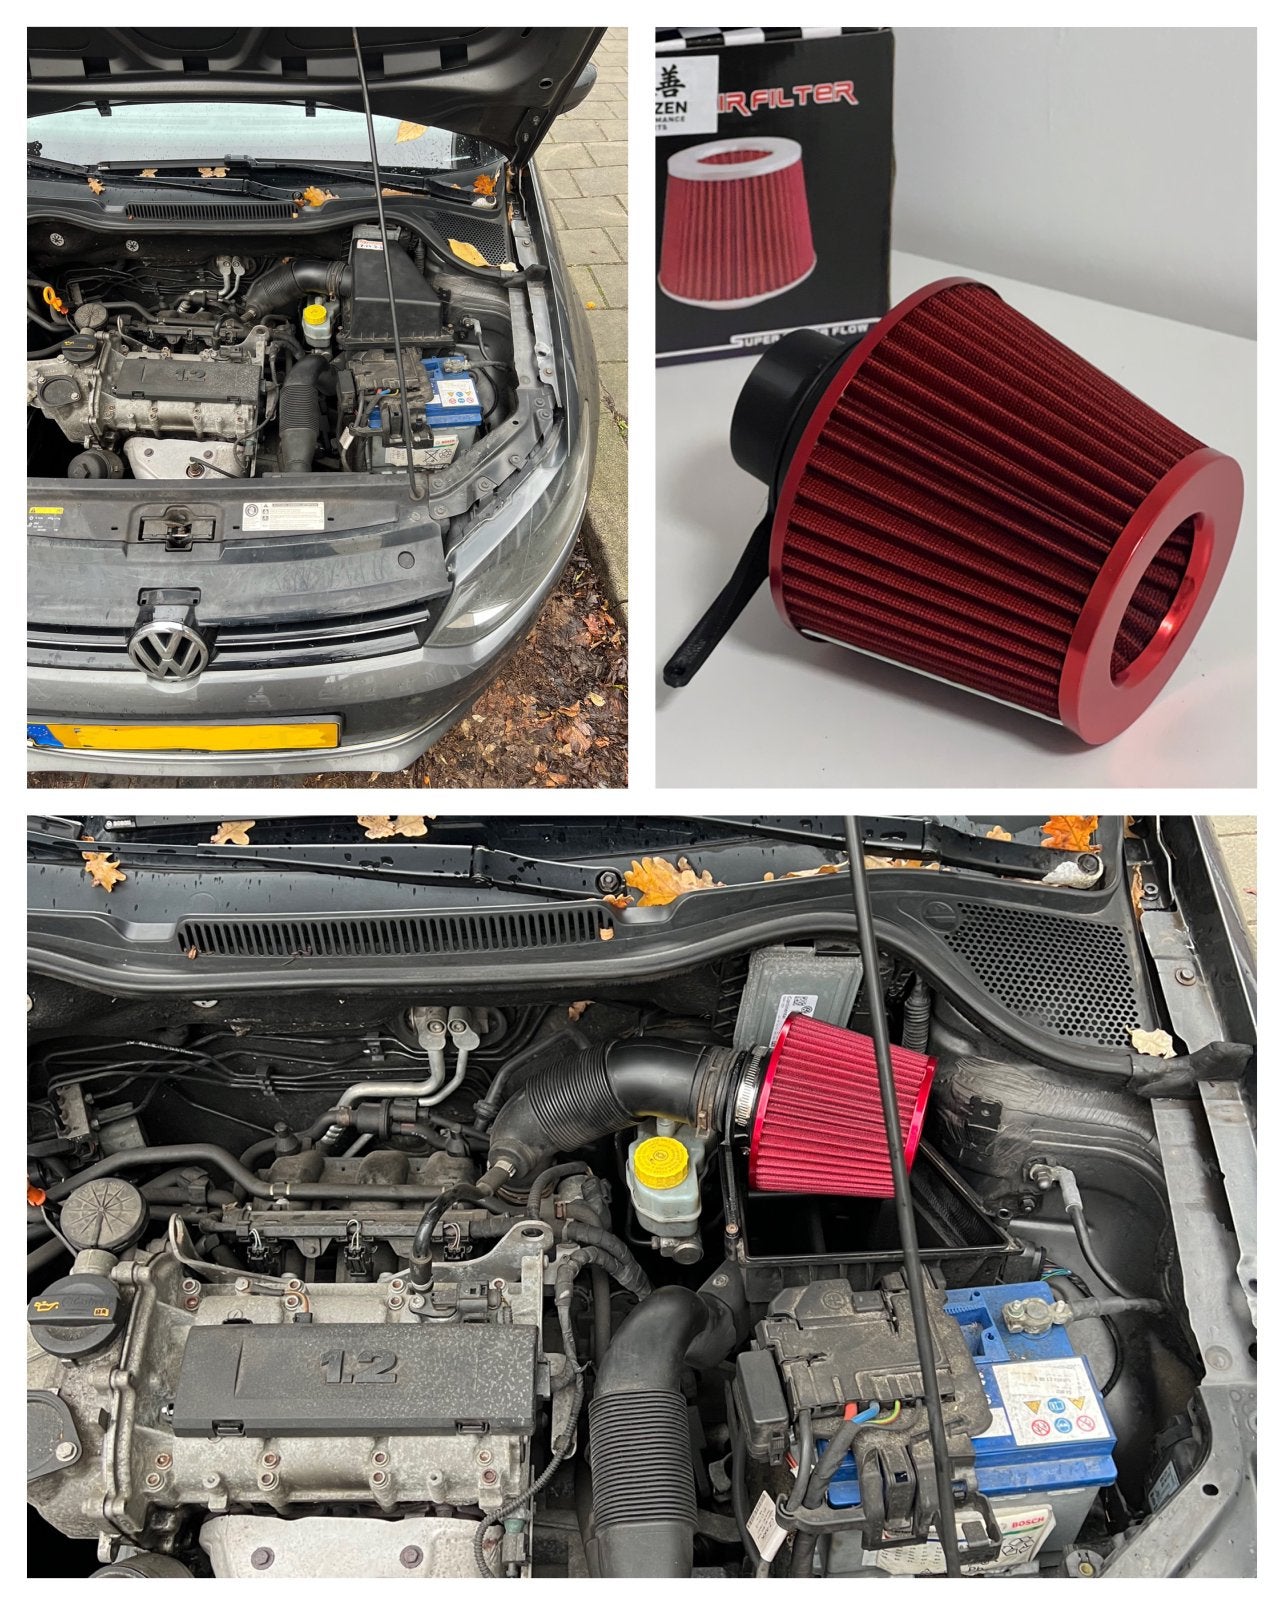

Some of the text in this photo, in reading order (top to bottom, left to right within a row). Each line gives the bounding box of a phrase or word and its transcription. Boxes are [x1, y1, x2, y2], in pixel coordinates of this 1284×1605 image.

[750, 80, 859, 111] FILTER
[831, 323, 869, 336] FLOW
[320, 1350, 398, 1384] 1.2
[1011, 1516, 1045, 1529] BOSCH
